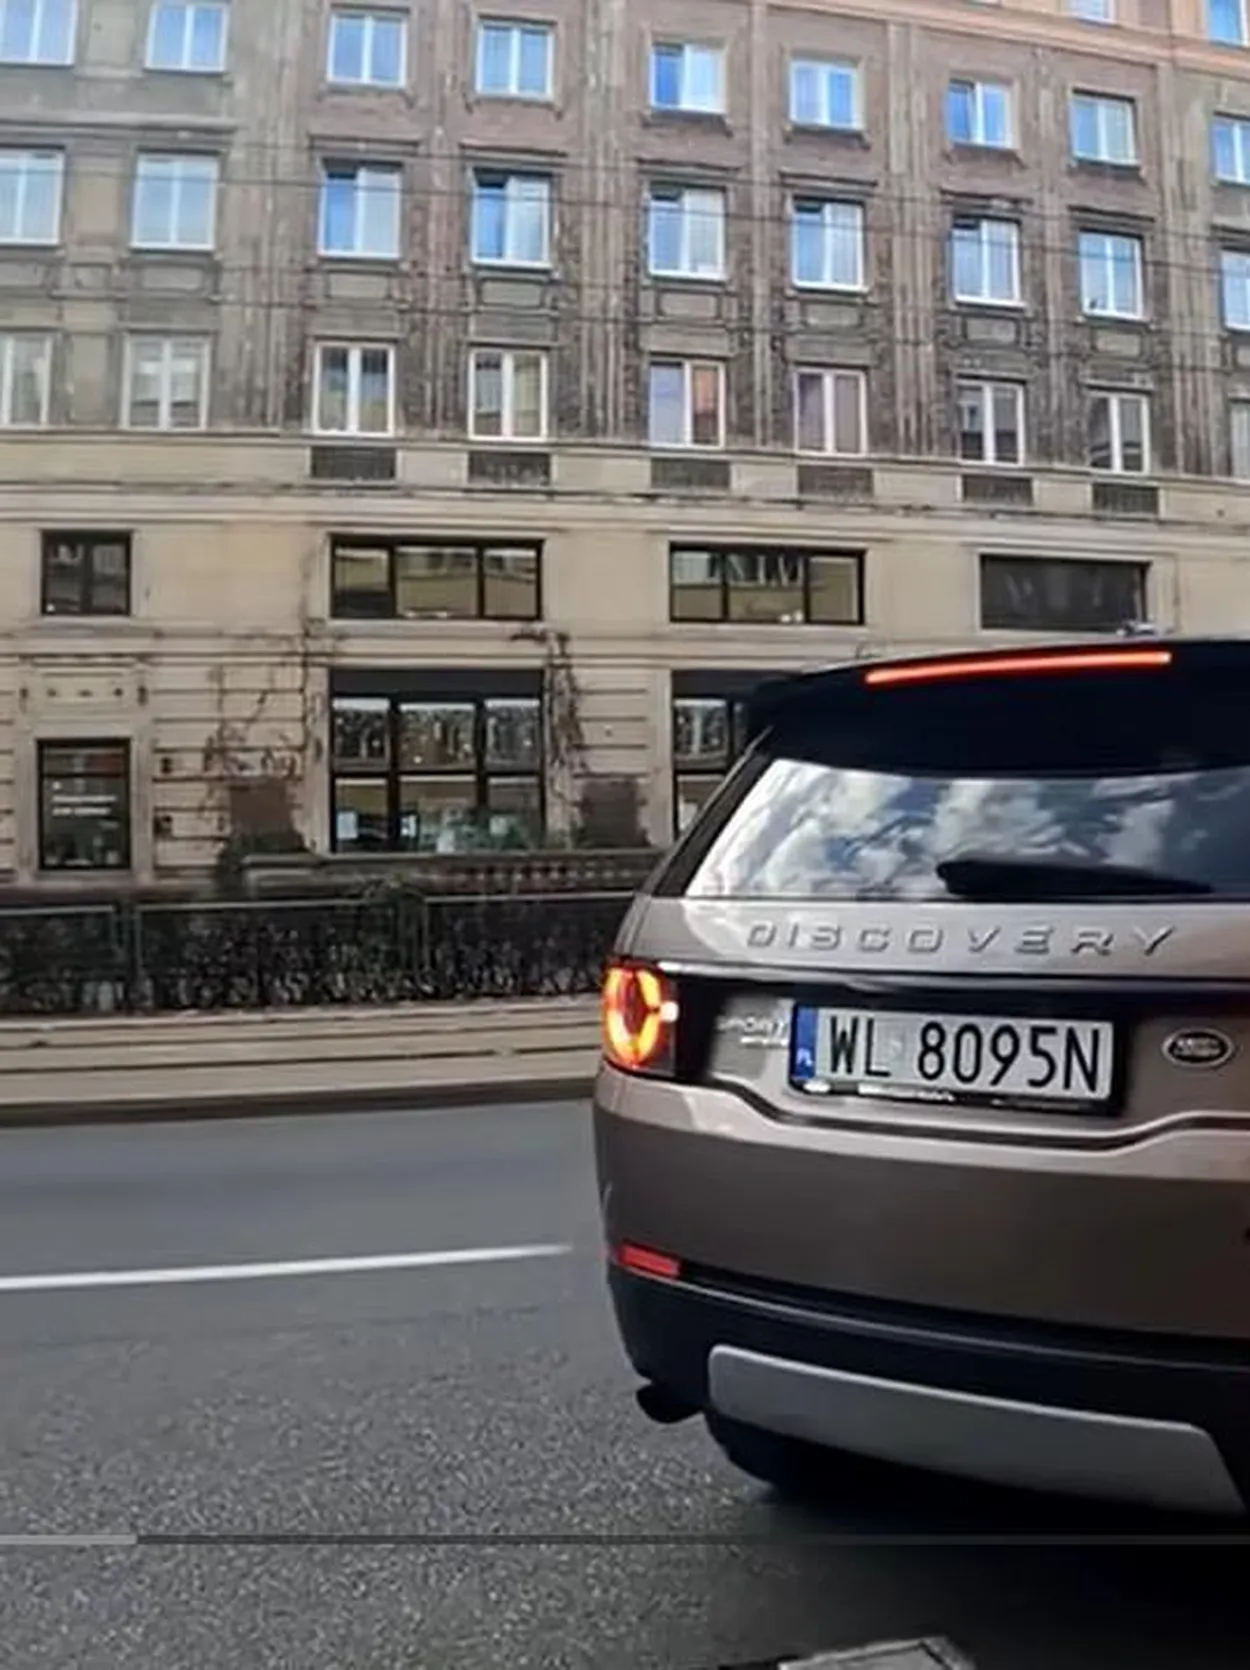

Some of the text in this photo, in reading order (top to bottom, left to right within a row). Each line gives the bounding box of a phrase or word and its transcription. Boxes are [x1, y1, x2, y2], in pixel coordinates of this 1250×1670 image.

[746, 921, 1178, 956] DISCOVERY
[829, 1014, 1102, 1094] WL 8095N
